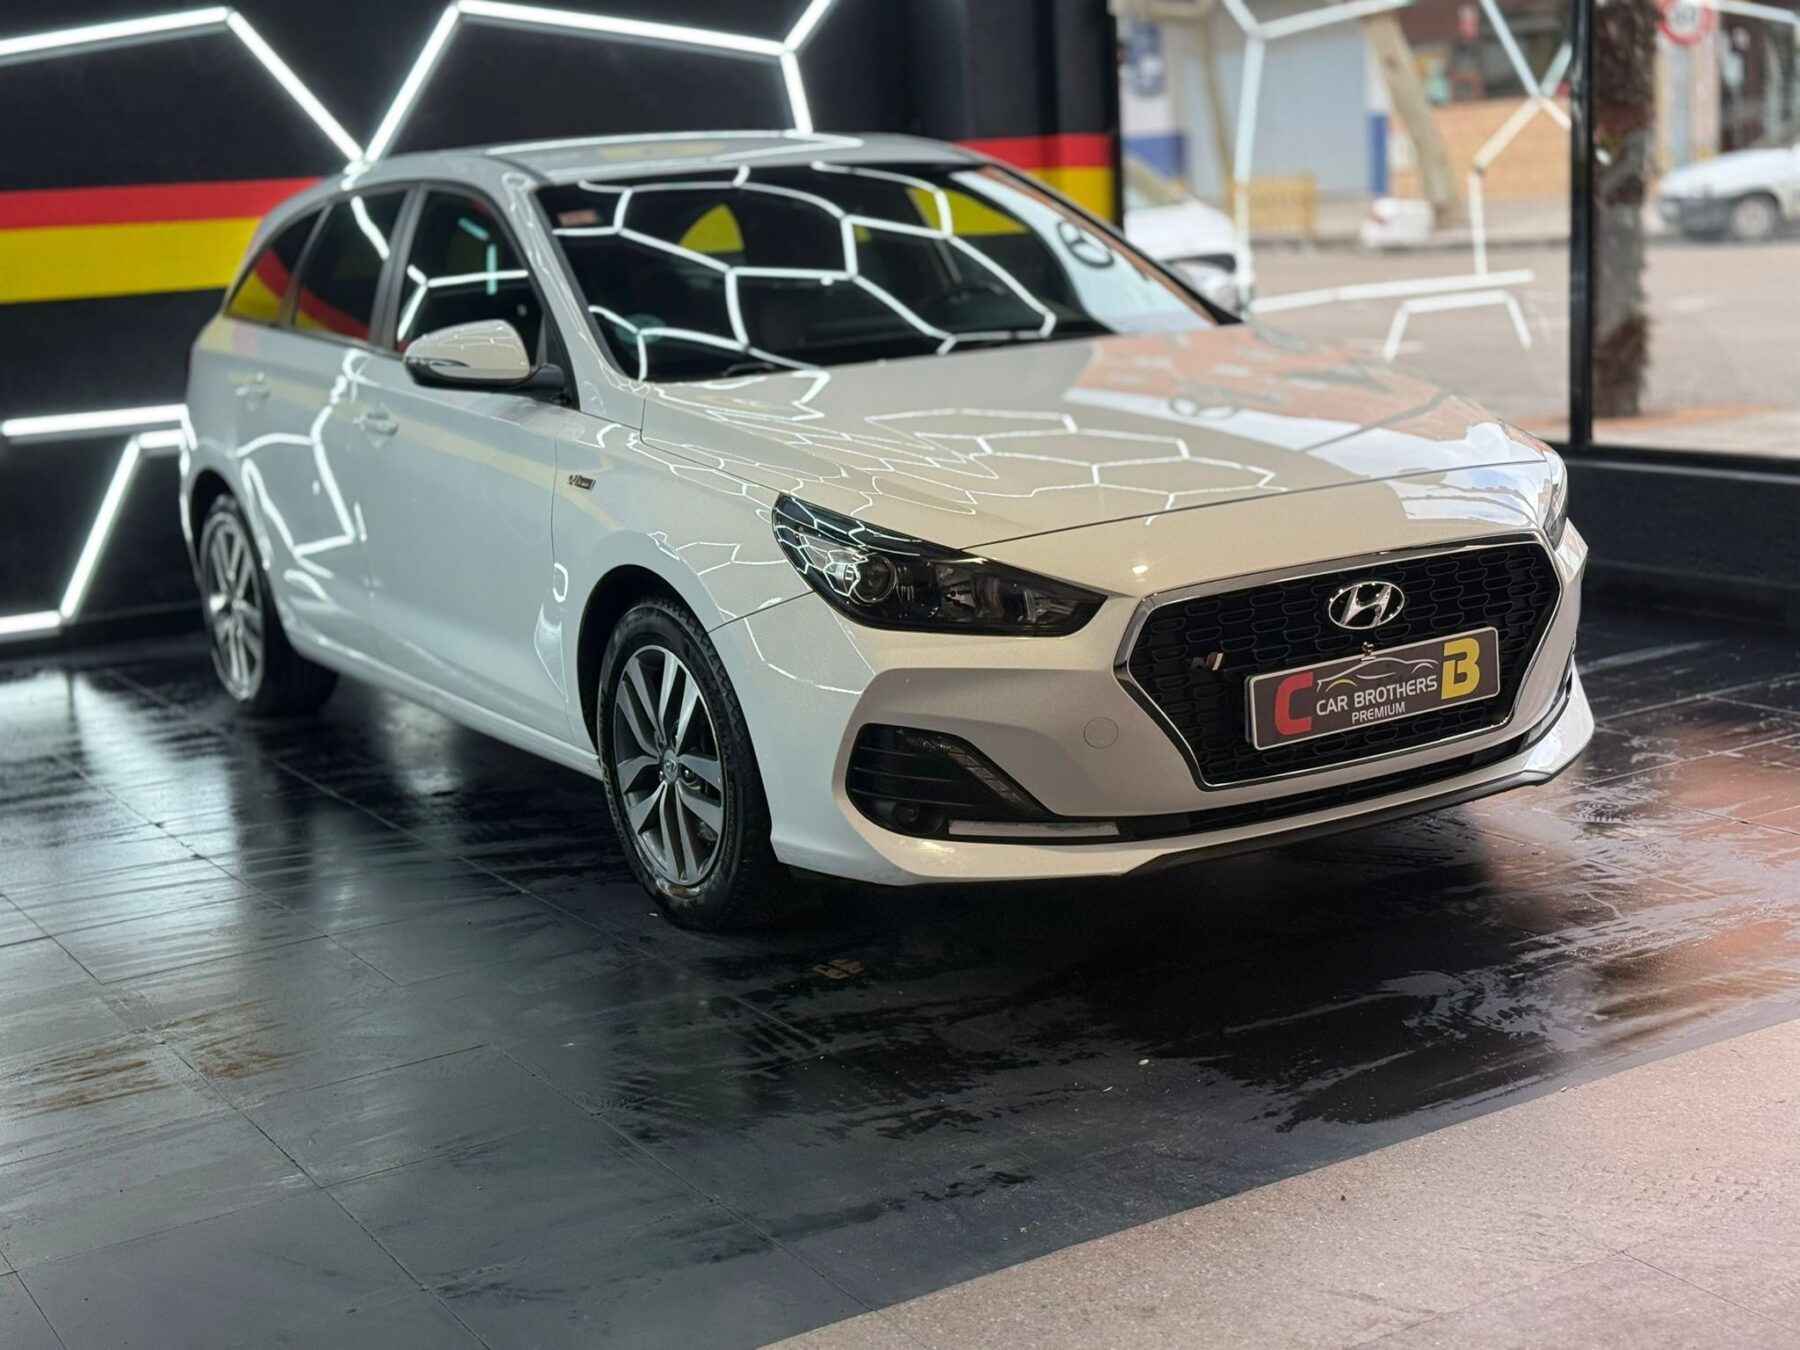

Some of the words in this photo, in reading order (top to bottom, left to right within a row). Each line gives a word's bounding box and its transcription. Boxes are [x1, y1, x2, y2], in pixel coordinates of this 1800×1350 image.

[1440, 637, 1480, 700] B
[1273, 670, 1314, 735] C
[1315, 694, 1349, 716] CAR
[1353, 674, 1438, 708] BROTHERS
[1351, 701, 1406, 725] PREMIUM
